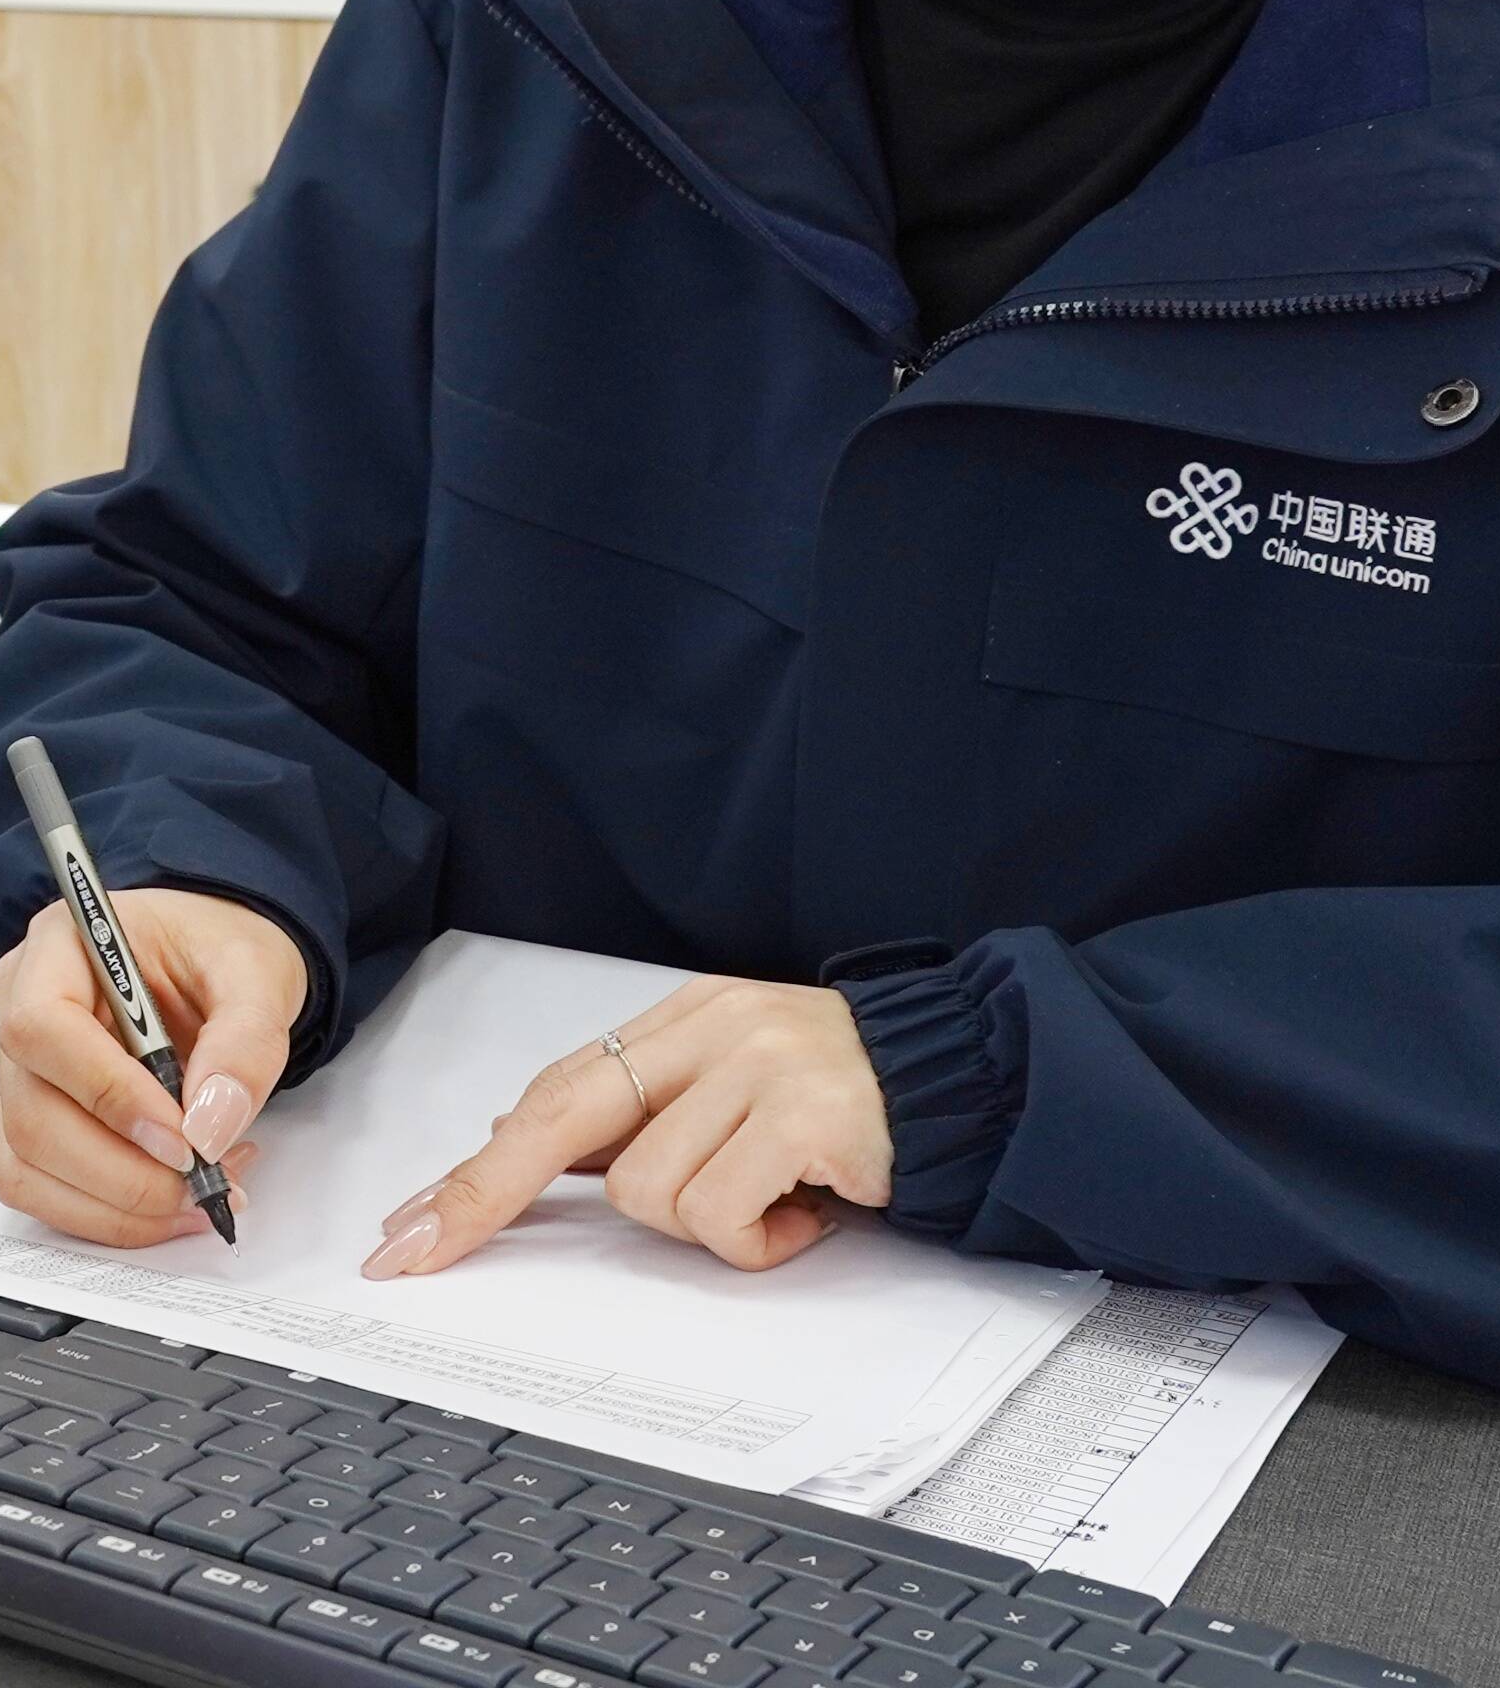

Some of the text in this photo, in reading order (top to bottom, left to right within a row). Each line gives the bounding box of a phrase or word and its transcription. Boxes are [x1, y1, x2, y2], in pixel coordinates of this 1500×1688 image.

[1267, 489, 1438, 564] 中国联通
[1261, 536, 1432, 595] China unicom
[5, 1371, 42, 1384] enter
